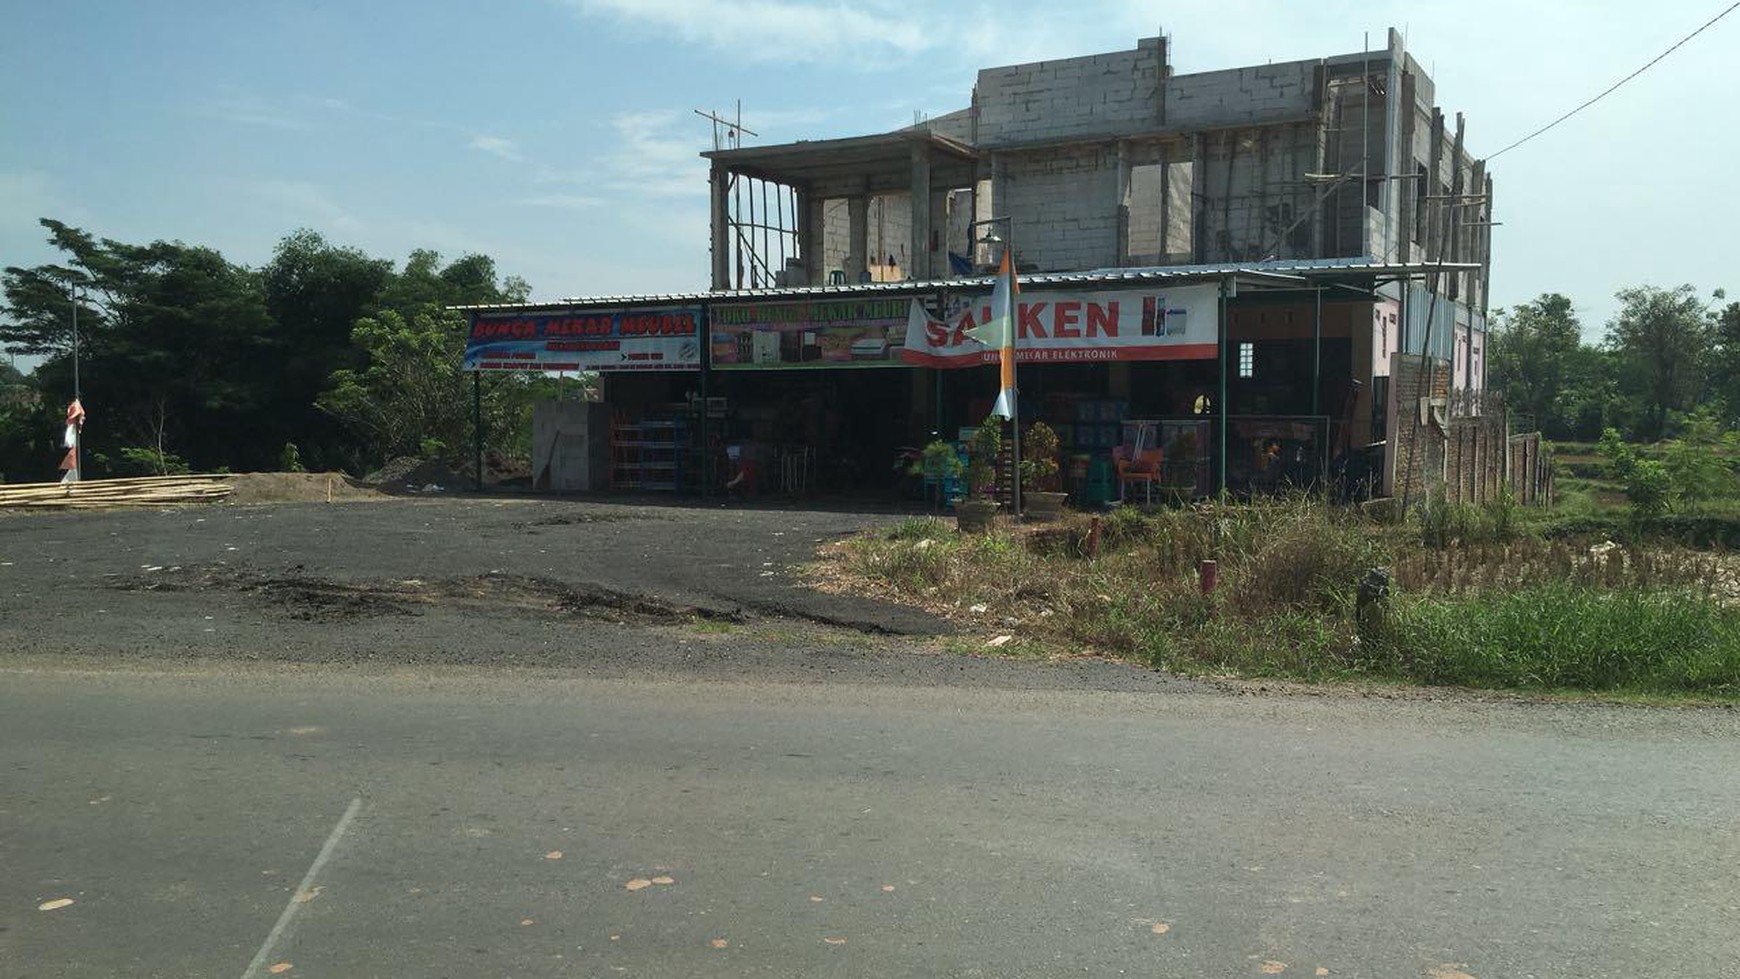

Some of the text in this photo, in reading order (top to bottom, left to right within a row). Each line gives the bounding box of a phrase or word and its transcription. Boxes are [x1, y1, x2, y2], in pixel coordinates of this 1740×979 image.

[544, 316, 612, 336] MEKAR
[620, 314, 695, 336] MEUBEL
[1052, 349, 1118, 360] ELEKTRONIK
